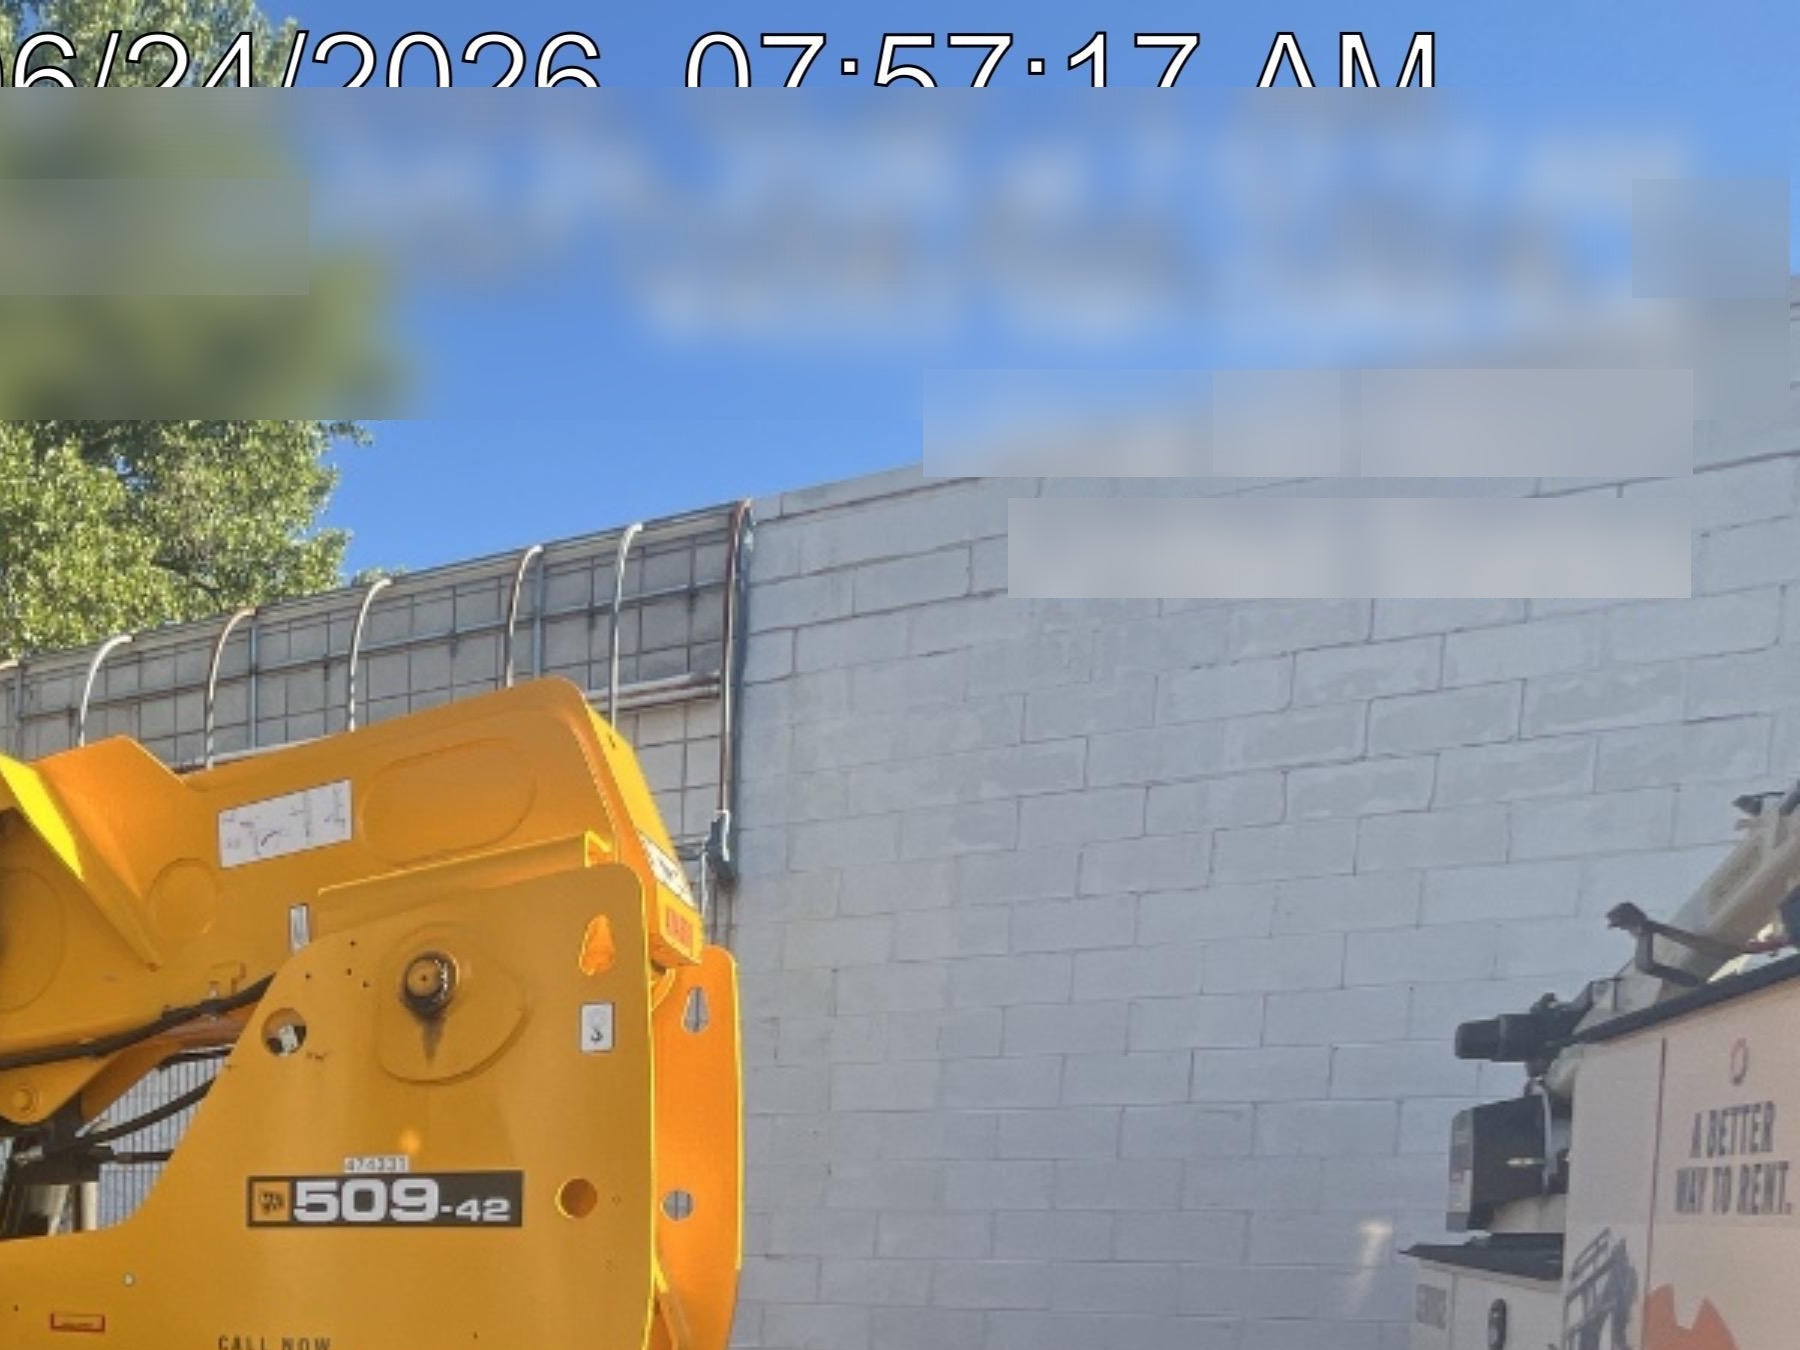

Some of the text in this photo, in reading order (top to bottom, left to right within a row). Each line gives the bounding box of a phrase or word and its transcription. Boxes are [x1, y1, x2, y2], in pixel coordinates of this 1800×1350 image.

[1706, 1100, 1775, 1158] BETTER
[293, 1177, 512, 1223] 509-42
[1712, 1165, 1732, 1214] TO
